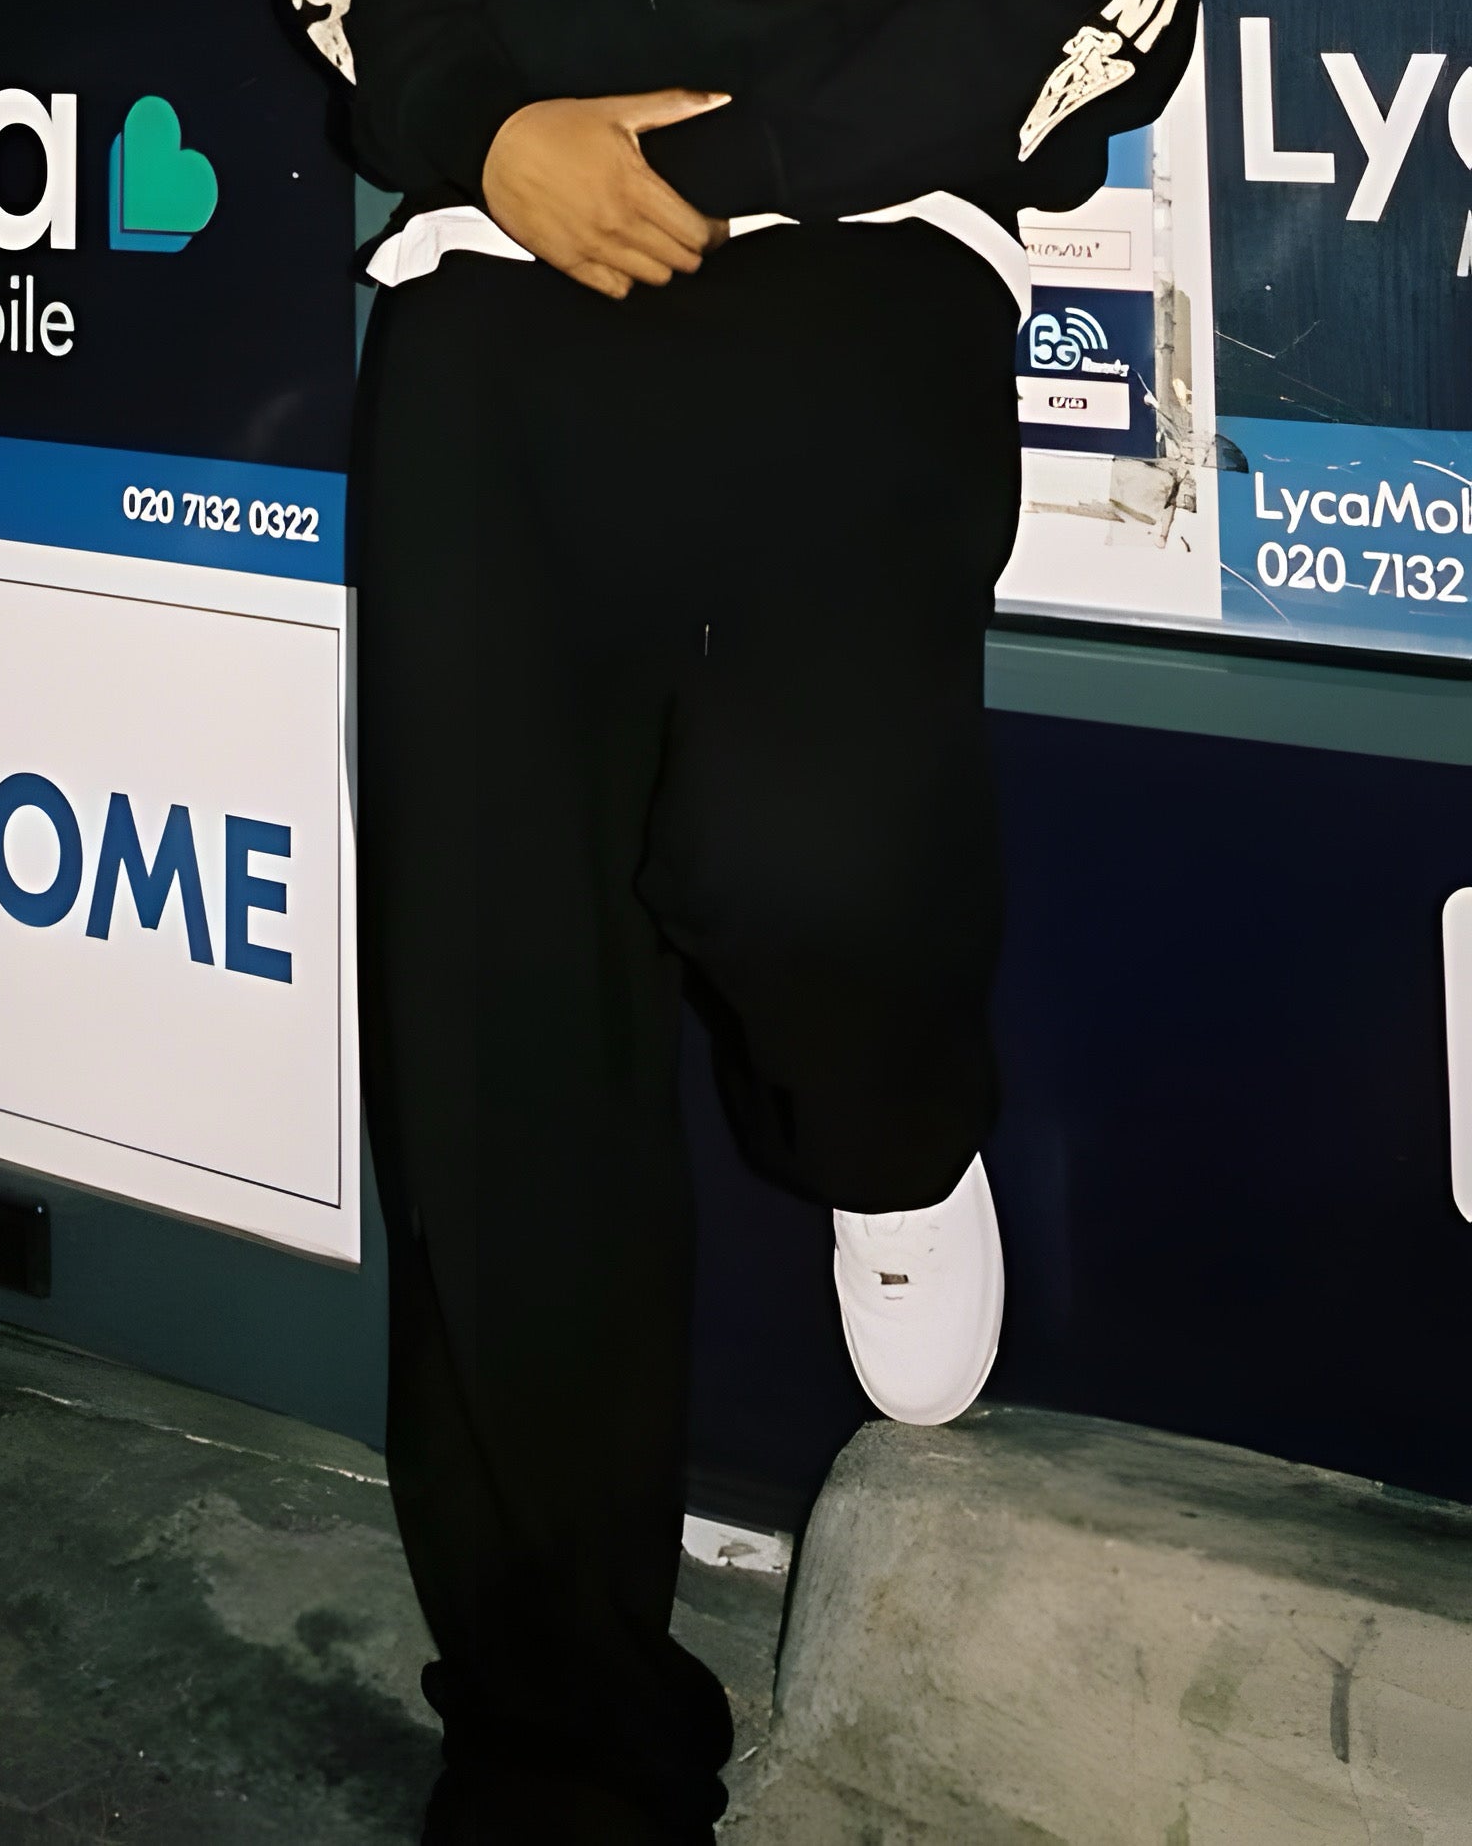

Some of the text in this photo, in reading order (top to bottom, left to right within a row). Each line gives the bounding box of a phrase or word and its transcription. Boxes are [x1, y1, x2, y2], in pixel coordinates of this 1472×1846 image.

[1240, 17, 1472, 222] Ly
[1031, 319, 1080, 368] 5G
[123, 486, 320, 543] 020 7132 0322
[1257, 541, 1469, 603] 020 7132
